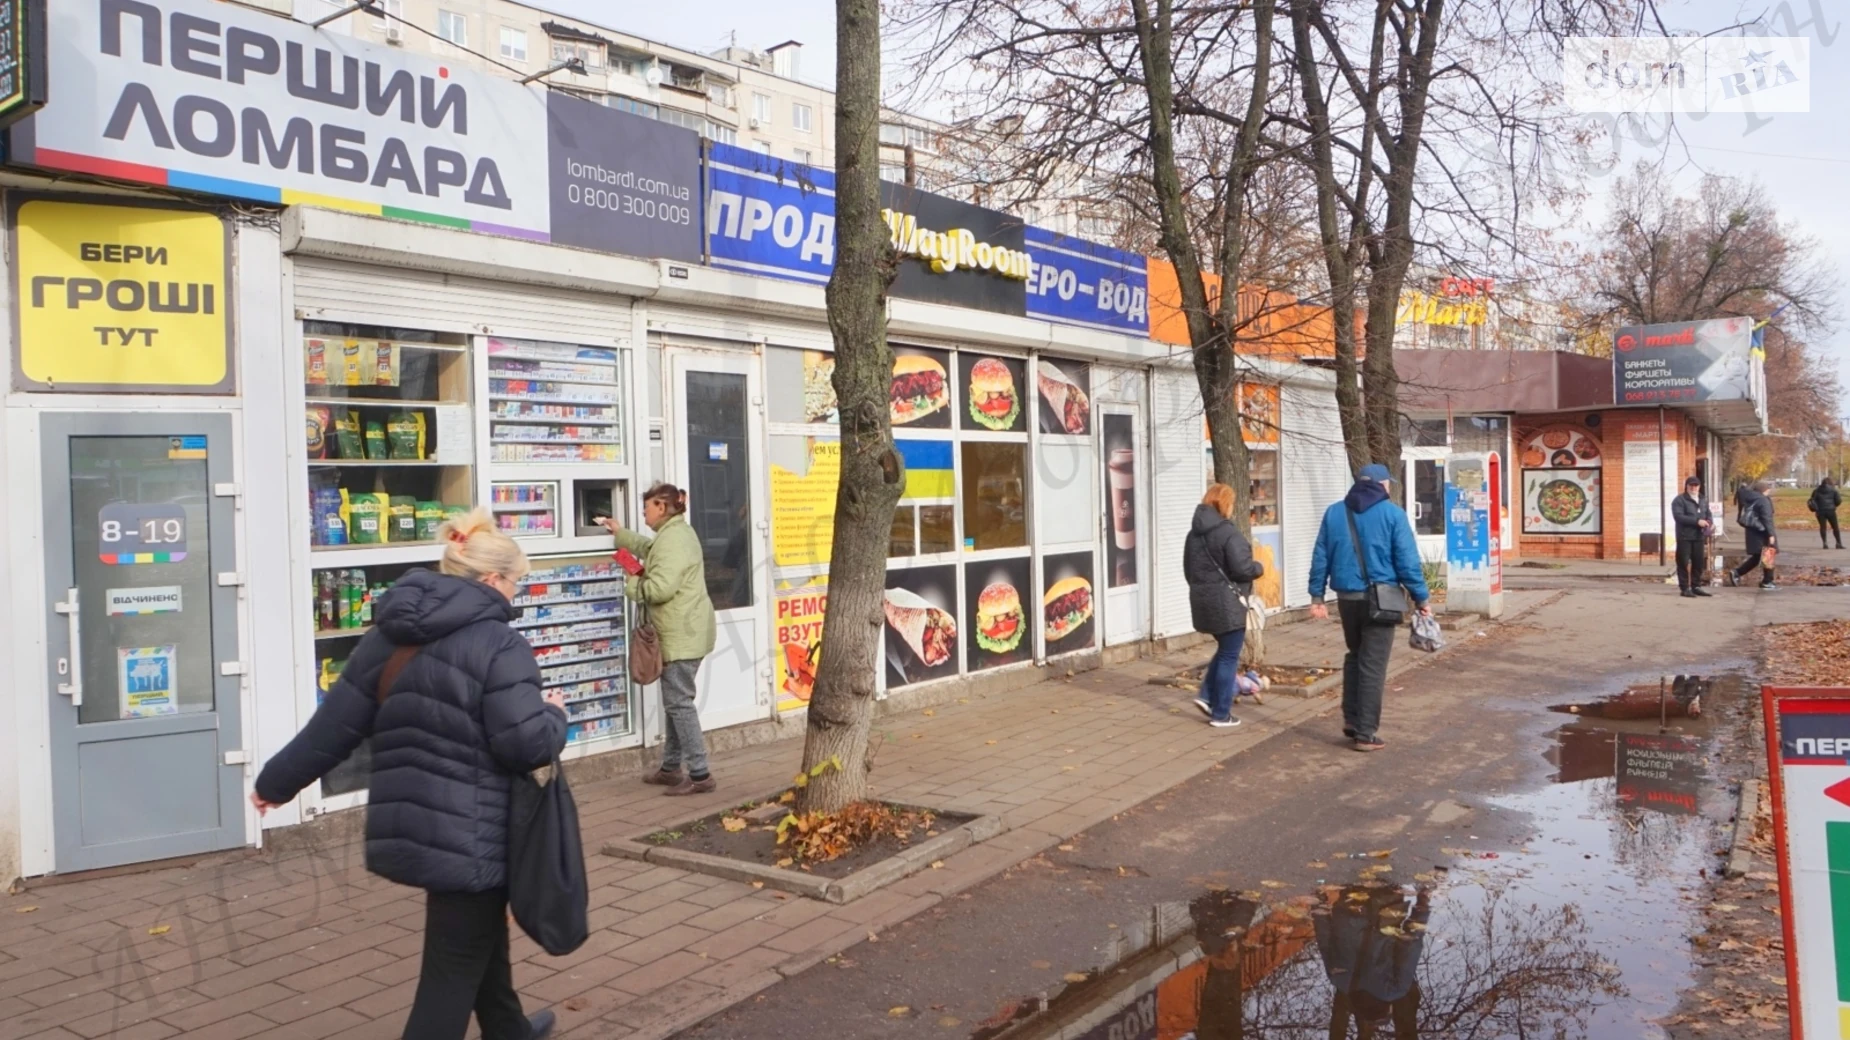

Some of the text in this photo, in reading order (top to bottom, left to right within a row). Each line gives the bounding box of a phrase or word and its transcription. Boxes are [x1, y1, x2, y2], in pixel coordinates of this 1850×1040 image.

[100, 0, 468, 136] ПЕРШИЙ
[102, 82, 513, 212] ЛОМБАРД
[567, 157, 690, 201] lombard1.com.ua
[568, 184, 690, 225] 0 800 300 009
[80, 242, 168, 267] БЕРИ
[31, 275, 215, 316] ГРОШІ
[93, 326, 160, 348] ТУТ
[1624, 359, 1666, 369] БАНКЕТЫ
[1624, 369, 1672, 379] ФУРШЕТЫ
[1624, 378, 1696, 389] КОРПОРАТИВЫ
